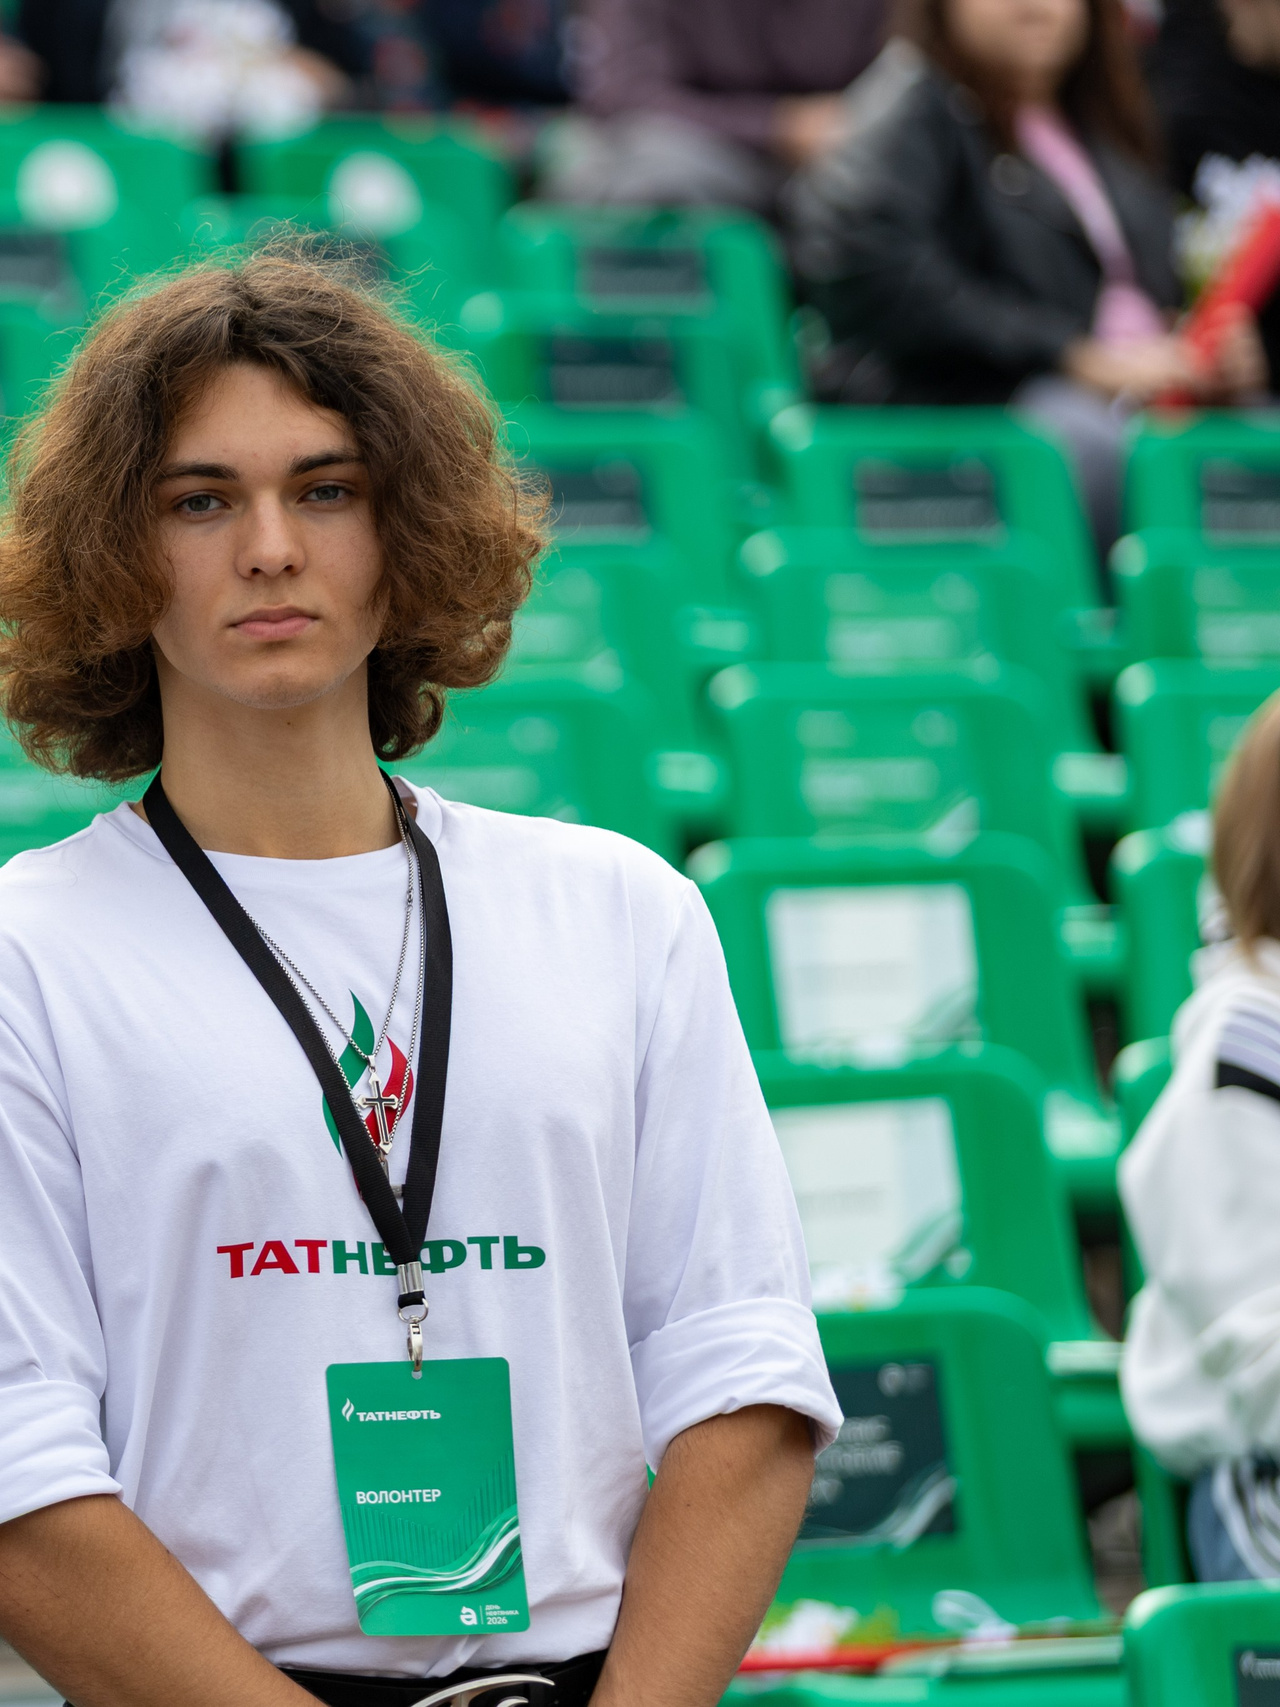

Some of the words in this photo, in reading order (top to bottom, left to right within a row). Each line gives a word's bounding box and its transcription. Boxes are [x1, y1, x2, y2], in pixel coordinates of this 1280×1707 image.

[216, 1235, 547, 1279] ТАТНЕФТЬ
[356, 1409, 442, 1422] ТАТНЕФТЬ
[356, 1488, 442, 1505] ВОЛОНТЕР
[486, 1616, 508, 1625] 2026
